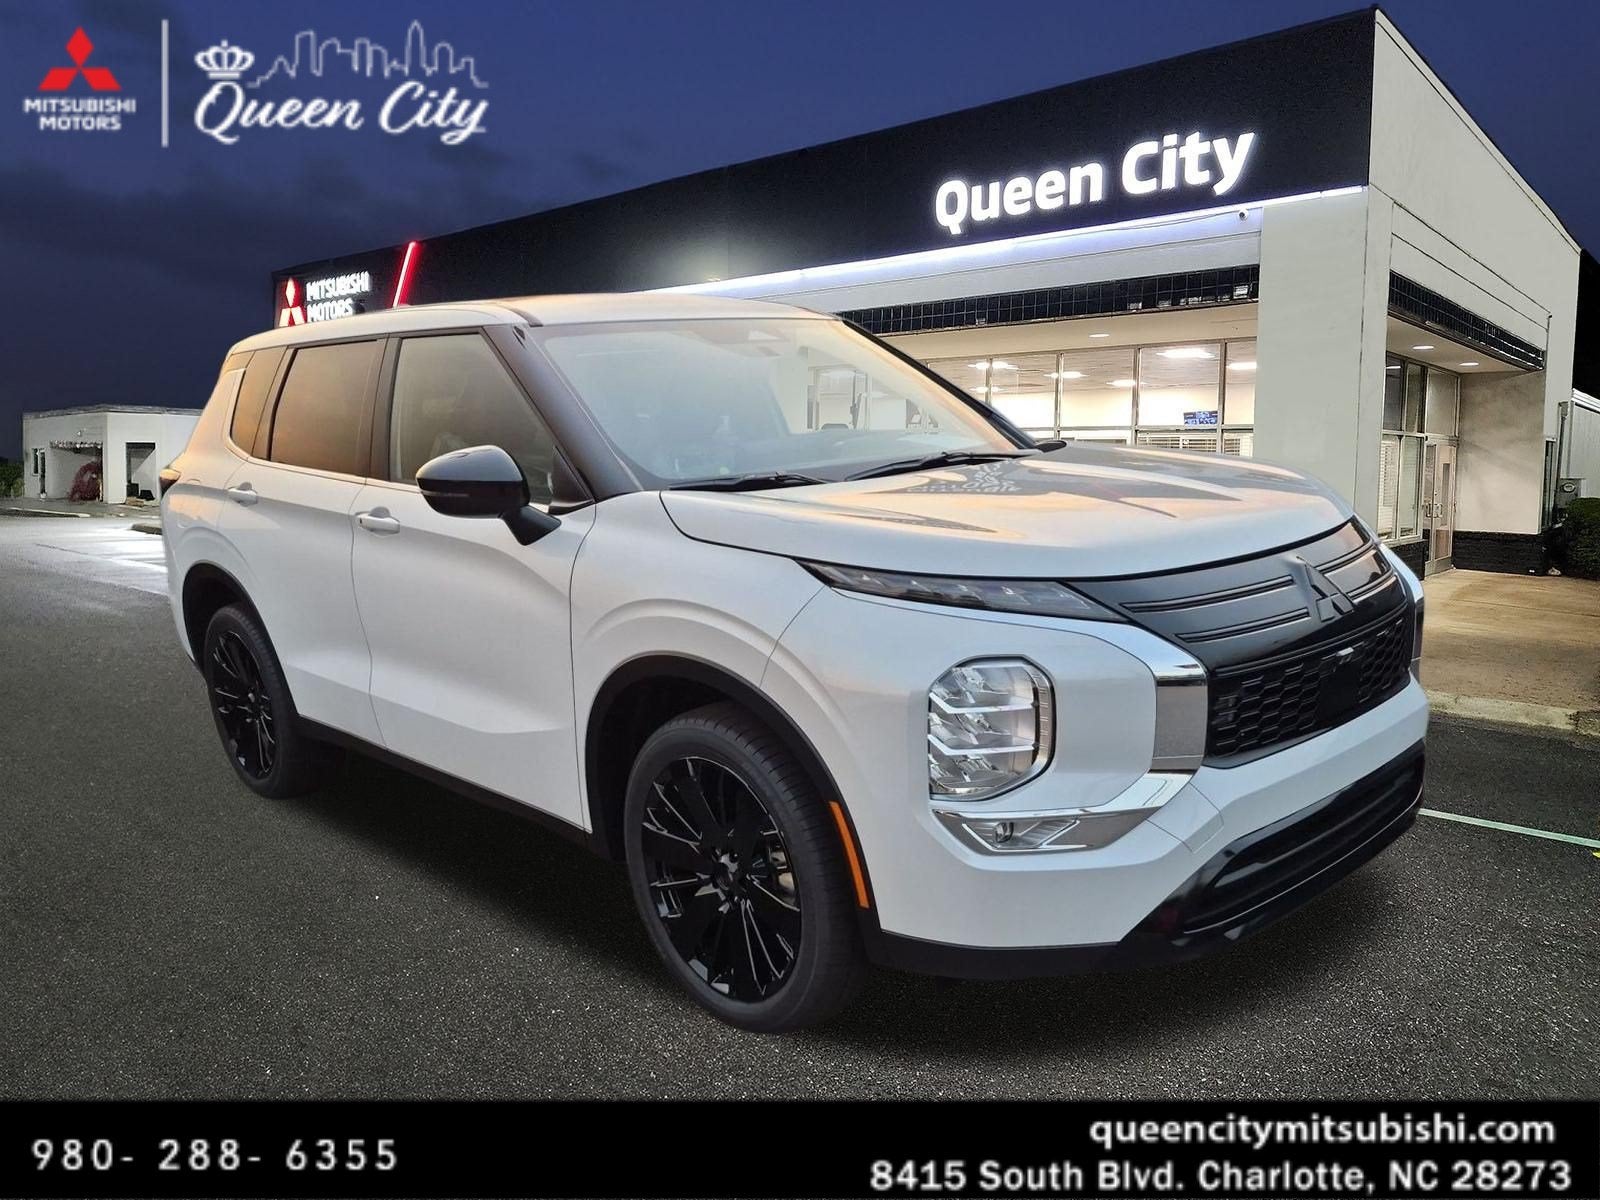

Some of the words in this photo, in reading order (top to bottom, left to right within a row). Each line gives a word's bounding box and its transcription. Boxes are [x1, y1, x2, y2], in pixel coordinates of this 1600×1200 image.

[935, 161, 1104, 235] Queen
[1121, 131, 1255, 197] City
[305, 271, 370, 301] MITSUBISHI
[306, 298, 354, 322] MOTORS
